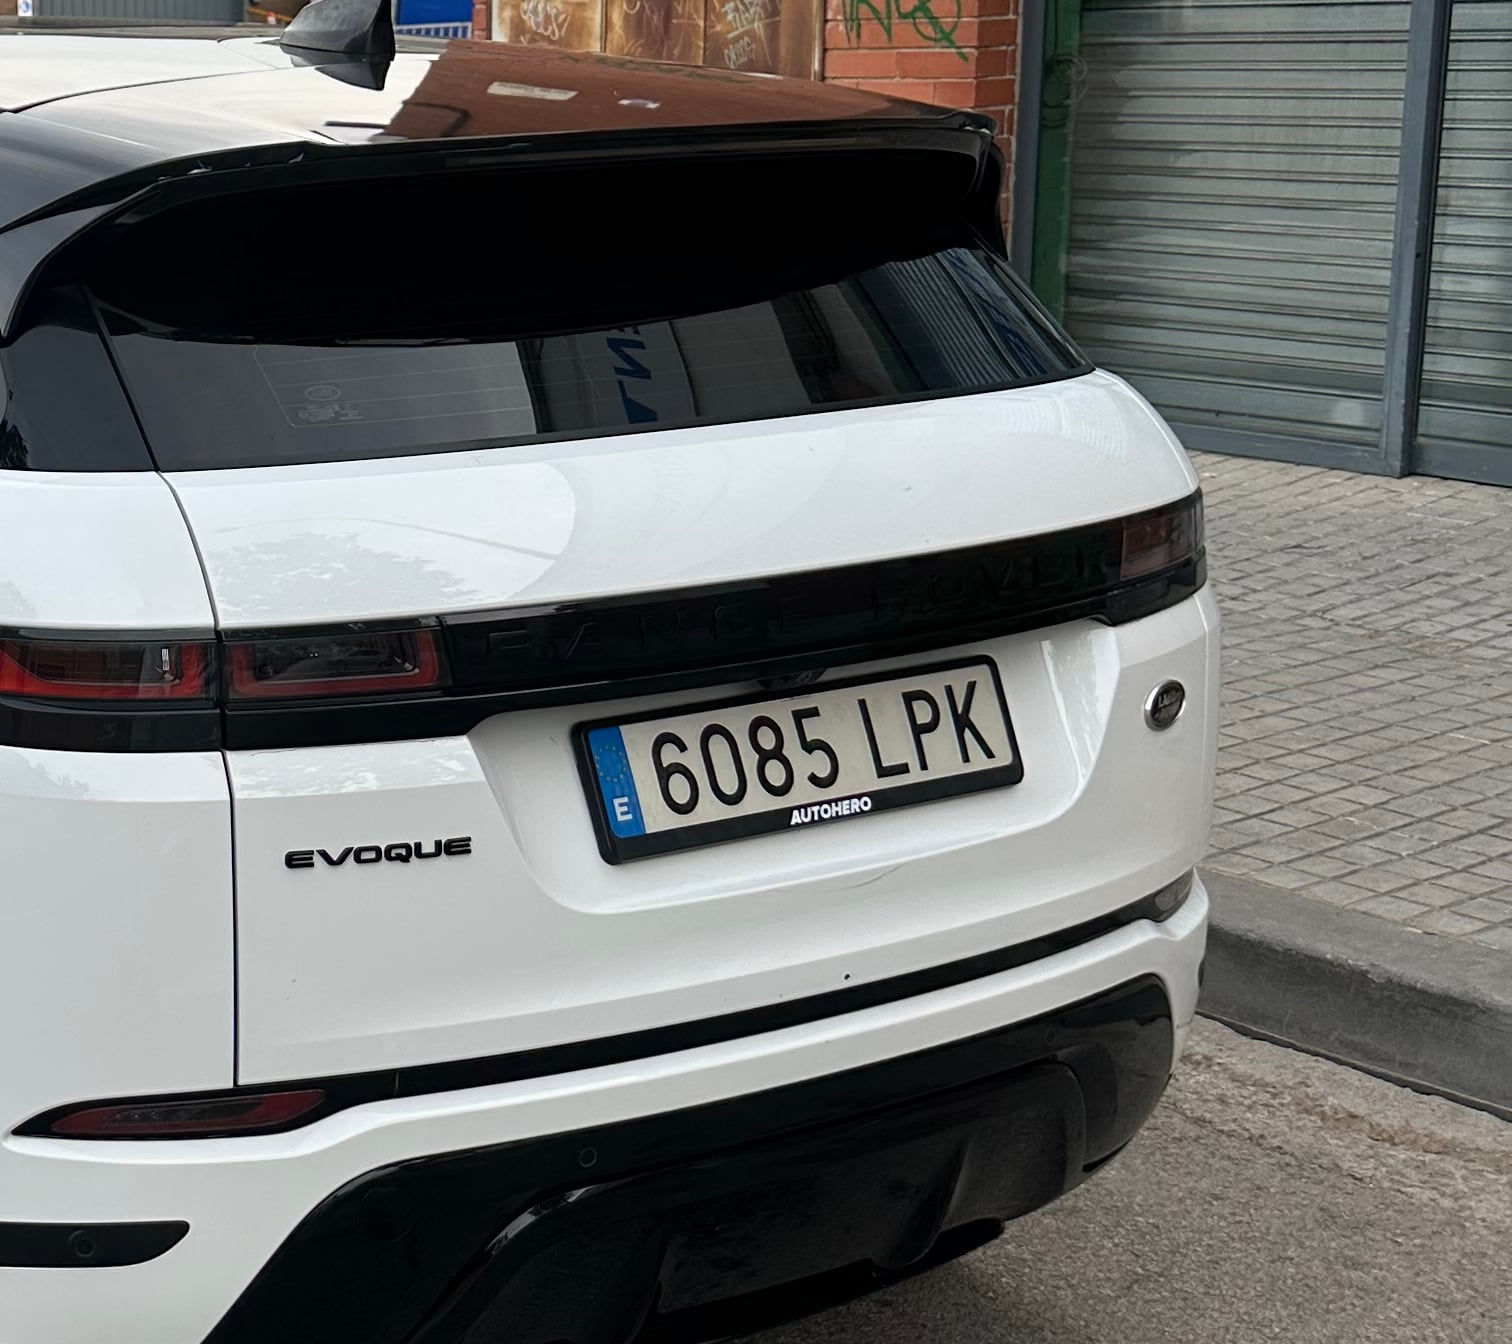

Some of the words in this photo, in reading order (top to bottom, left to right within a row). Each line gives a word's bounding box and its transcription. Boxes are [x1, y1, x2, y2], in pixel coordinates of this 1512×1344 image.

[651, 705, 839, 815] 6085
[857, 679, 996, 778] LPK
[613, 796, 633, 822] E
[790, 796, 872, 825] AUTOHERO
[284, 836, 472, 869] EVOQUE
